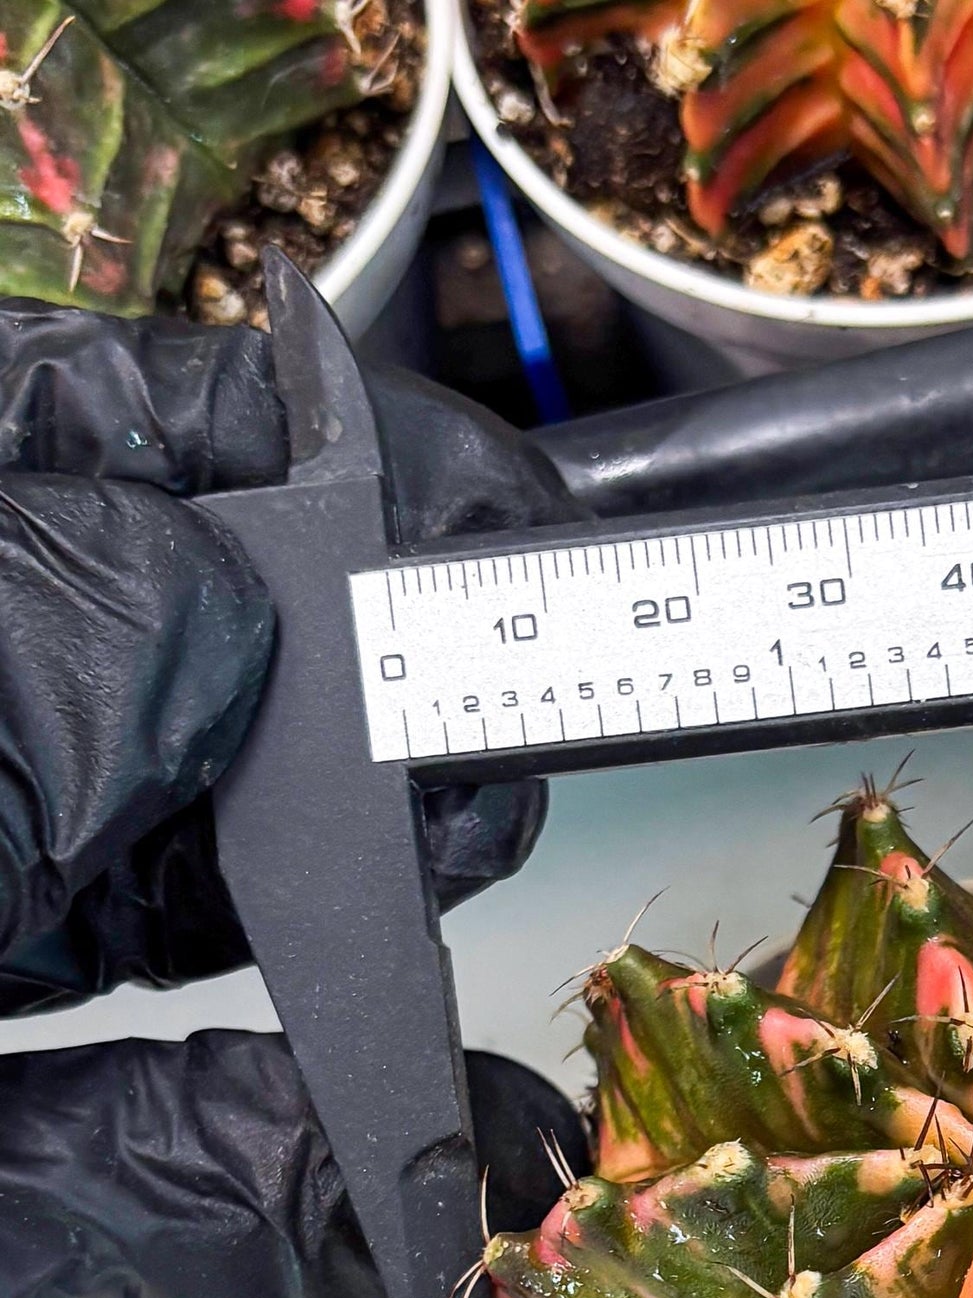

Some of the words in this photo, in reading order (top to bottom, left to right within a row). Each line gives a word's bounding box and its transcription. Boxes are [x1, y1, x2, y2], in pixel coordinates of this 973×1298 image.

[493, 614, 538, 643] 10
[632, 596, 692, 628] 20
[787, 577, 846, 609] 30
[380, 653, 406, 682] 0
[432, 699, 441, 716] 1
[462, 695, 480, 713] 2
[501, 690, 519, 708] 3
[540, 686, 556, 704] 4
[577, 681, 595, 700] 5
[617, 677, 634, 696] 6
[658, 673, 673, 691] 7
[693, 668, 712, 687] 8
[732, 664, 751, 683] 9
[769, 639, 784, 666] 1
[818, 656, 828, 672] 1
[848, 651, 867, 669] 2
[887, 646, 905, 664] 3
[926, 641, 942, 659] 4
